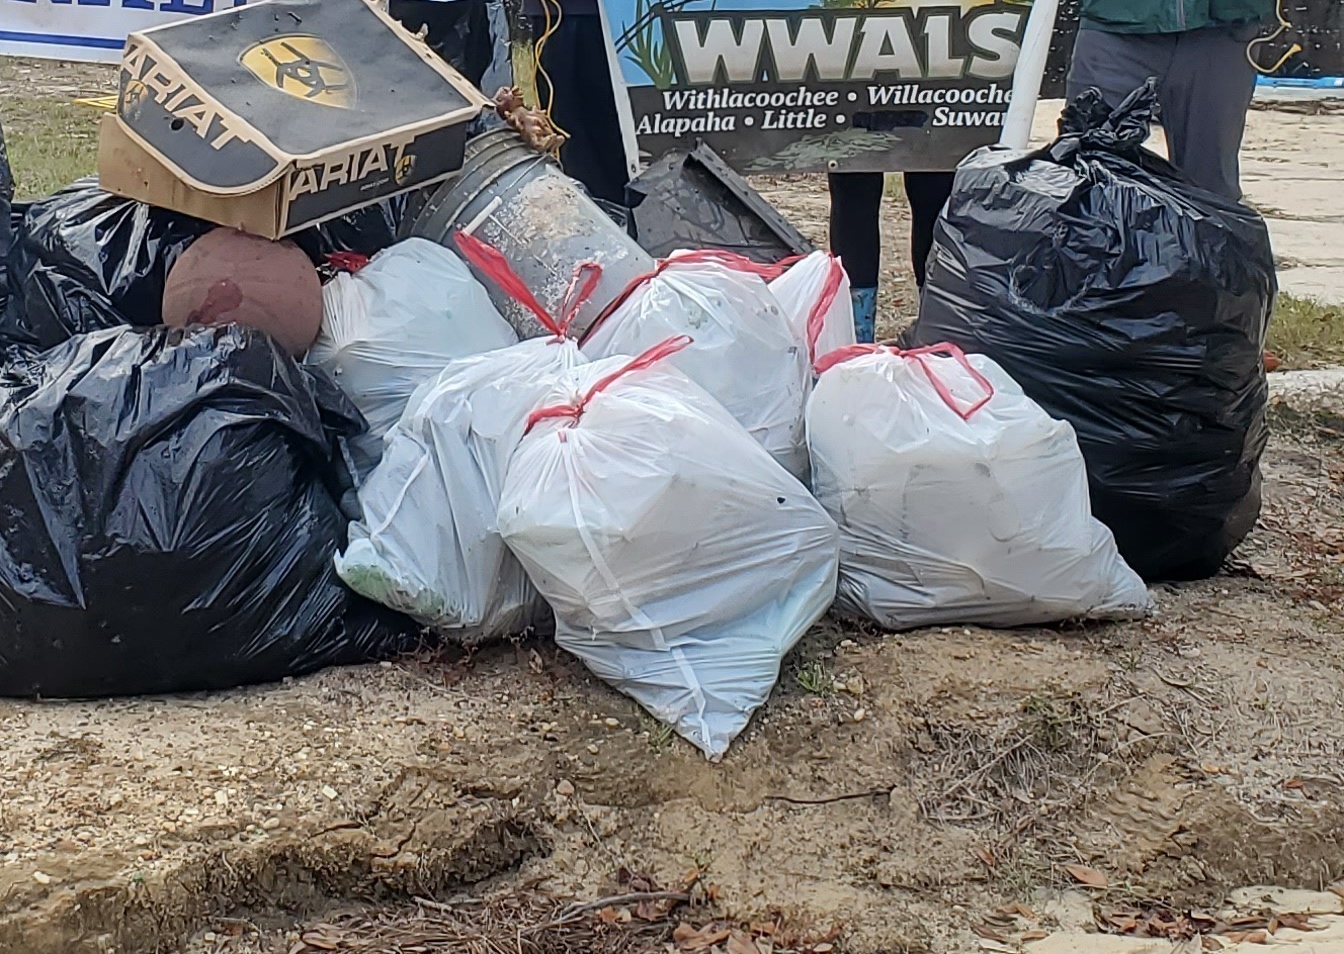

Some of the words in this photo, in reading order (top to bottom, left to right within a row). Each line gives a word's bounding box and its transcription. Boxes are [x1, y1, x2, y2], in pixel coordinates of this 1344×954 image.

[673, 11, 1022, 84] WWALS
[121, 43, 253, 151] ARIAT
[635, 111, 736, 138] Alapaha
[760, 109, 828, 130] Little
[662, 86, 839, 111] Withlacoochee
[288, 134, 416, 201] ARIAT
